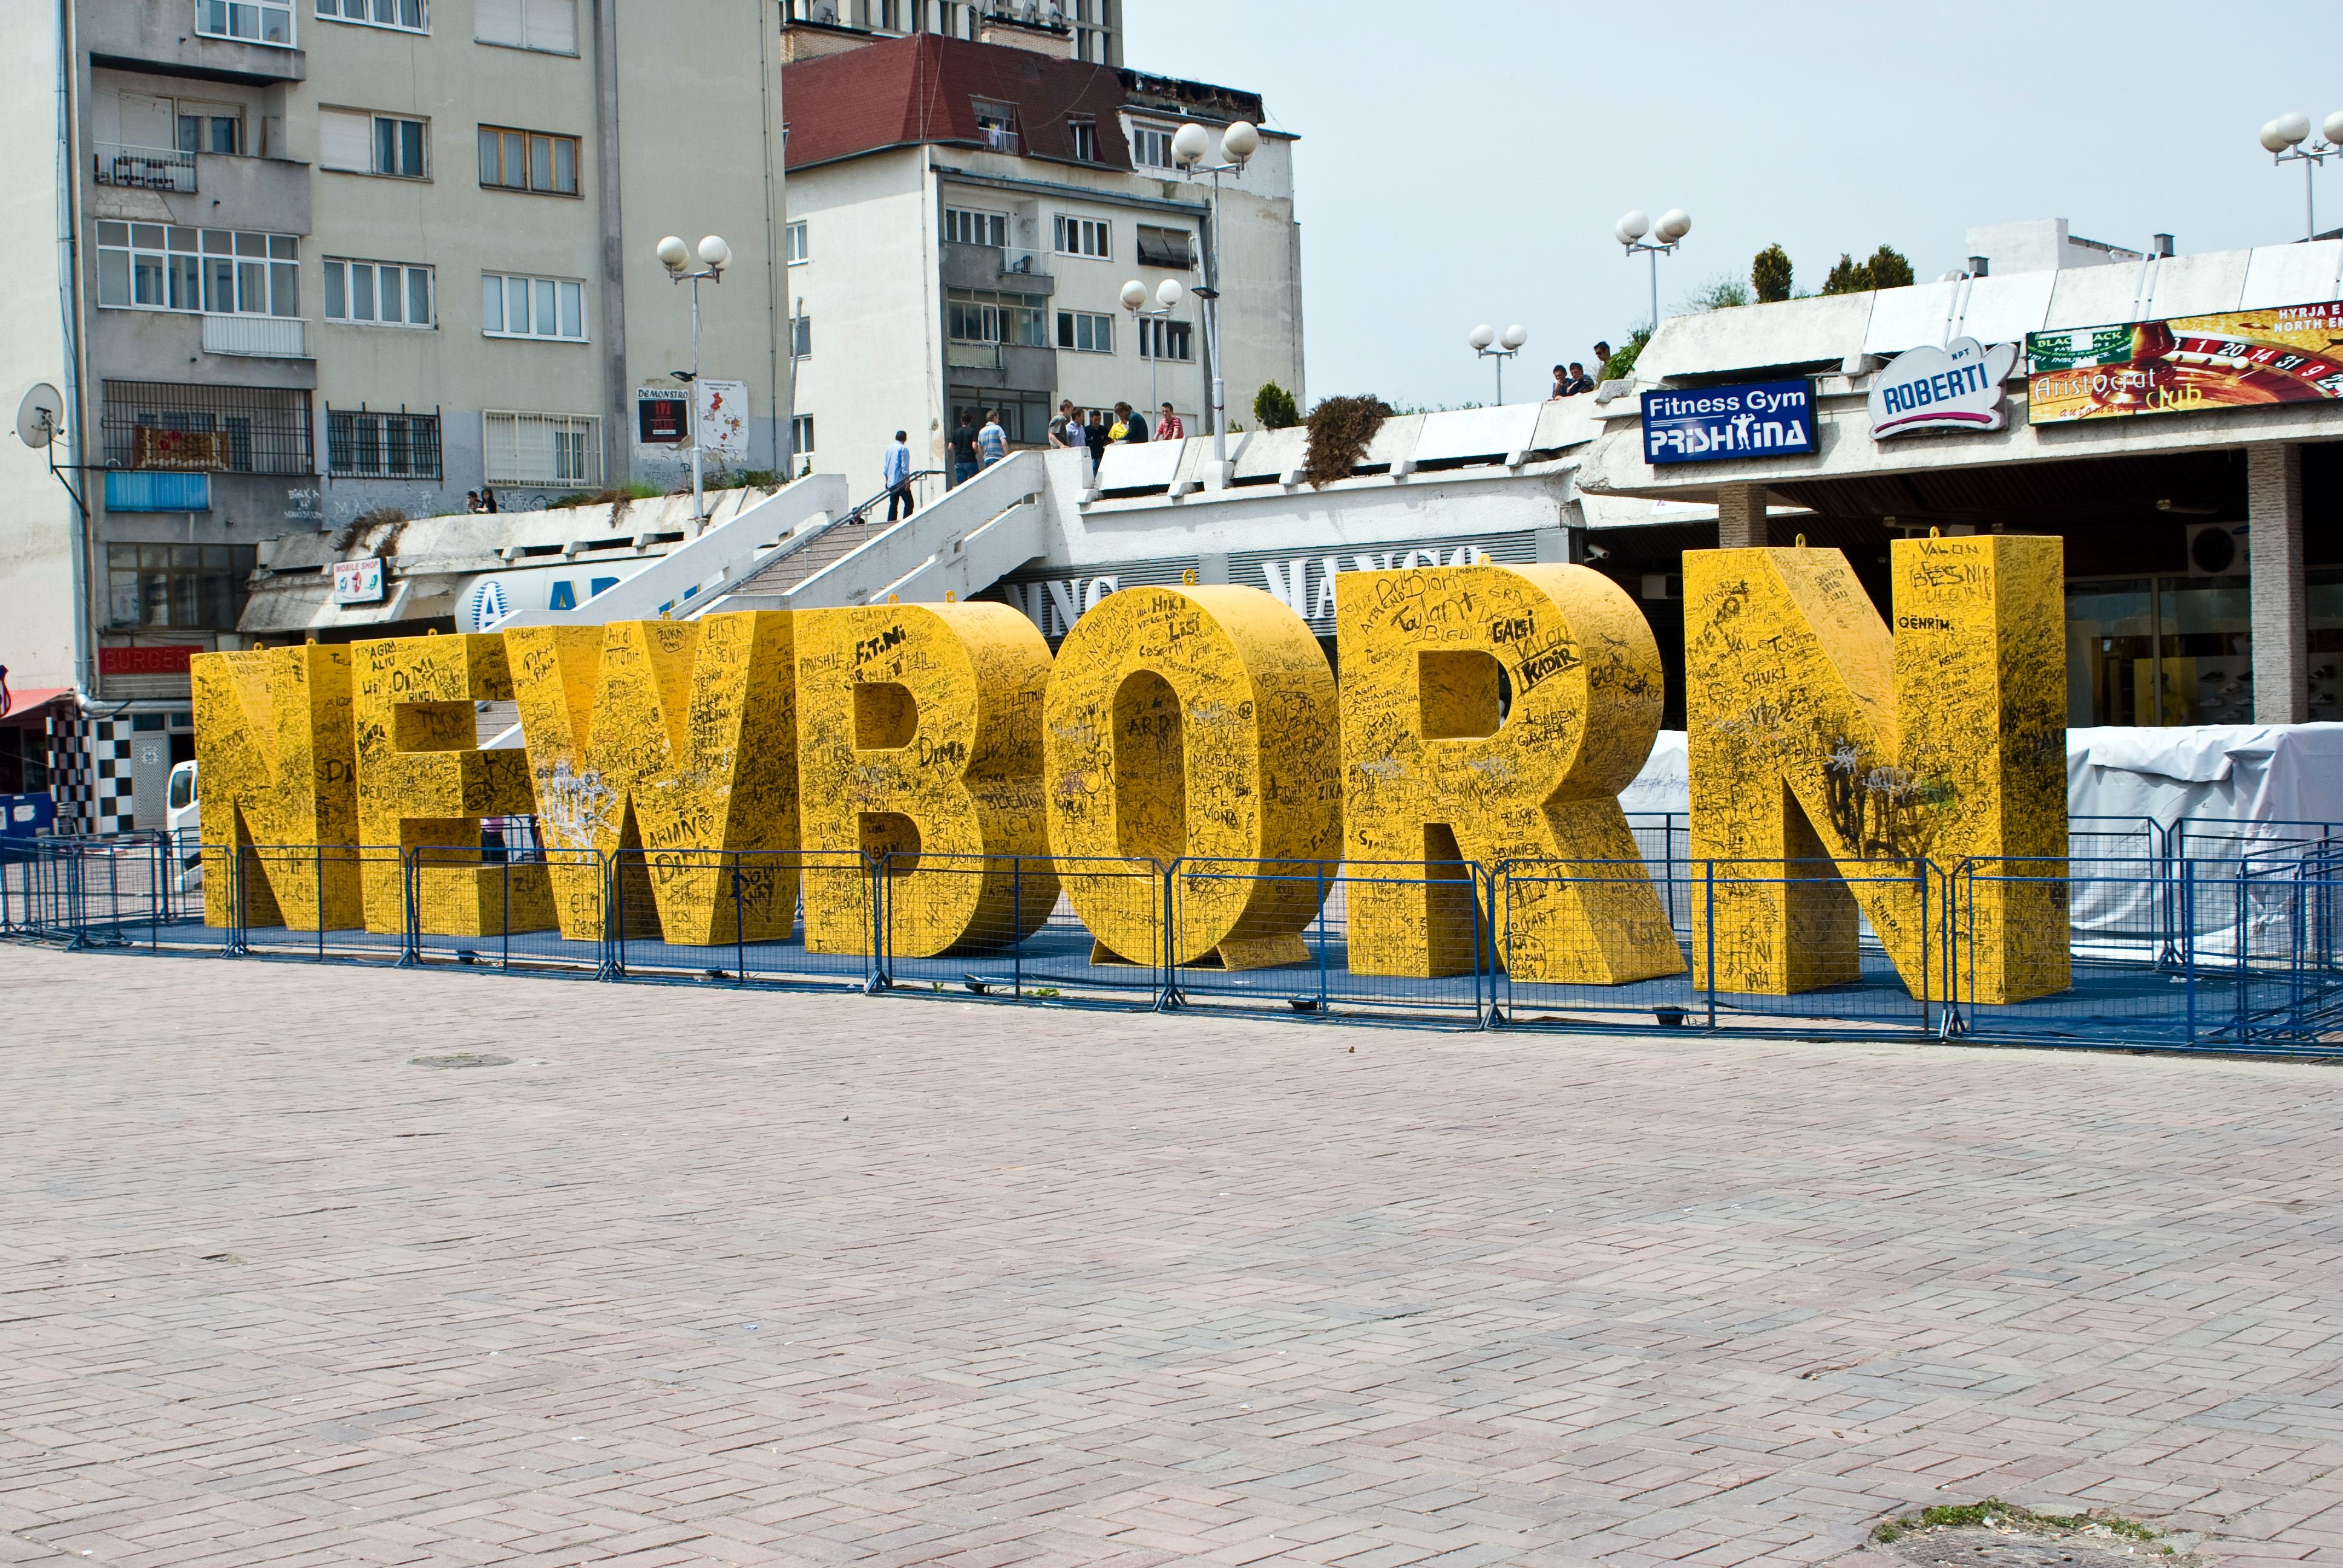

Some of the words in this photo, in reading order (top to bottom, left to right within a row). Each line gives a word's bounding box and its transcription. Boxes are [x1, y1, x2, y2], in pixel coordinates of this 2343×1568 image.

[2278, 305, 2326, 321] HYRJA
[2273, 318, 2323, 334] NORTH
[2037, 331, 2123, 348] BLACACK
[2197, 339, 2208, 352] 1
[2217, 342, 2247, 357] 20
[2249, 348, 2276, 363] 14
[2275, 354, 2305, 370] 31
[2300, 365, 2326, 377] 9
[1883, 362, 1988, 415] ROBERTI
[2034, 368, 2156, 404] Aristocrat
[1650, 397, 1740, 417] Fitness
[1746, 390, 1805, 413] Gym
[336, 563, 359, 572] MOBILE
[361, 561, 379, 570] SHOP
[189, 532, 2072, 1007] NEWBORN
